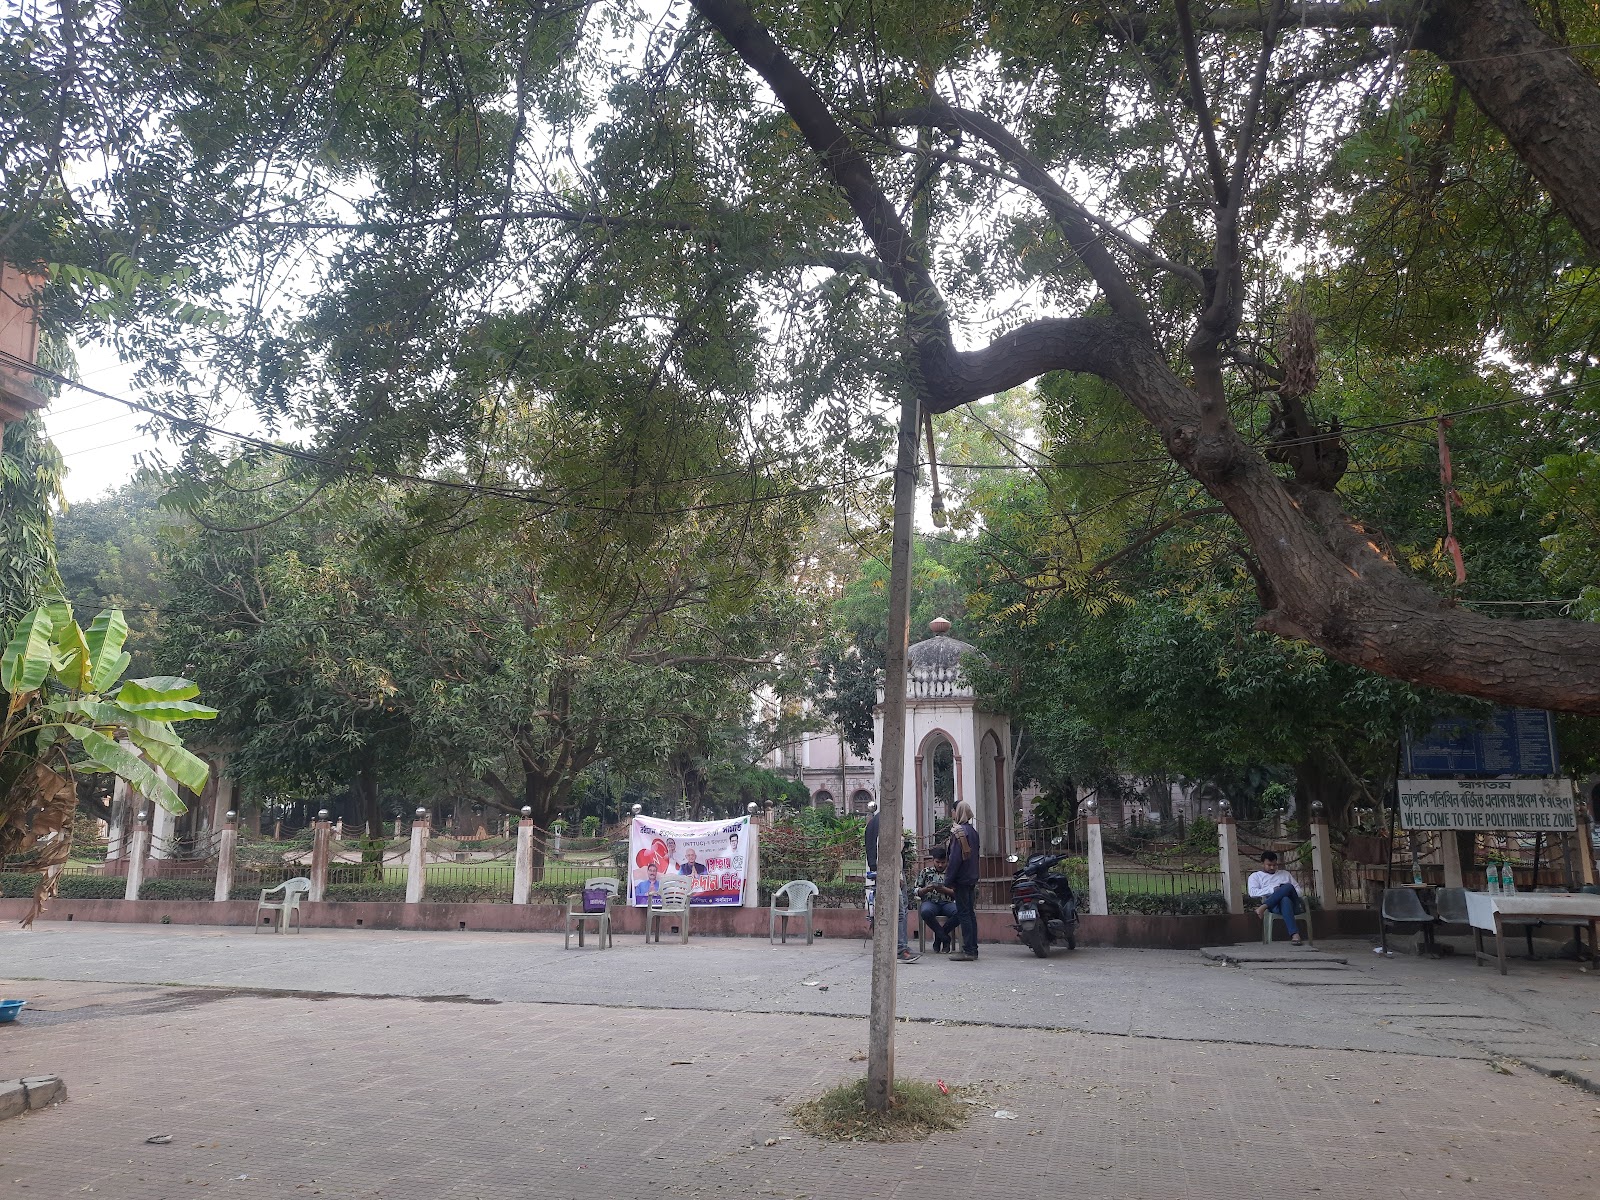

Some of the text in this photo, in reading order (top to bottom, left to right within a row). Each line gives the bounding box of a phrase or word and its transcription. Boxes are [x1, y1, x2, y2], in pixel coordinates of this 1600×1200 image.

[1458, 781, 1511, 790] স্বাগতম
[1401, 791, 1429, 808] আপনি
[1429, 791, 1459, 808] পলিথিন
[1460, 791, 1484, 808] বর্জিত
[1485, 793, 1515, 808] এলাকায়
[1516, 793, 1537, 808] প্রবেশ
[1404, 812, 1575, 828] WELCOME TO THE POLYTHINE FREE ZONE
